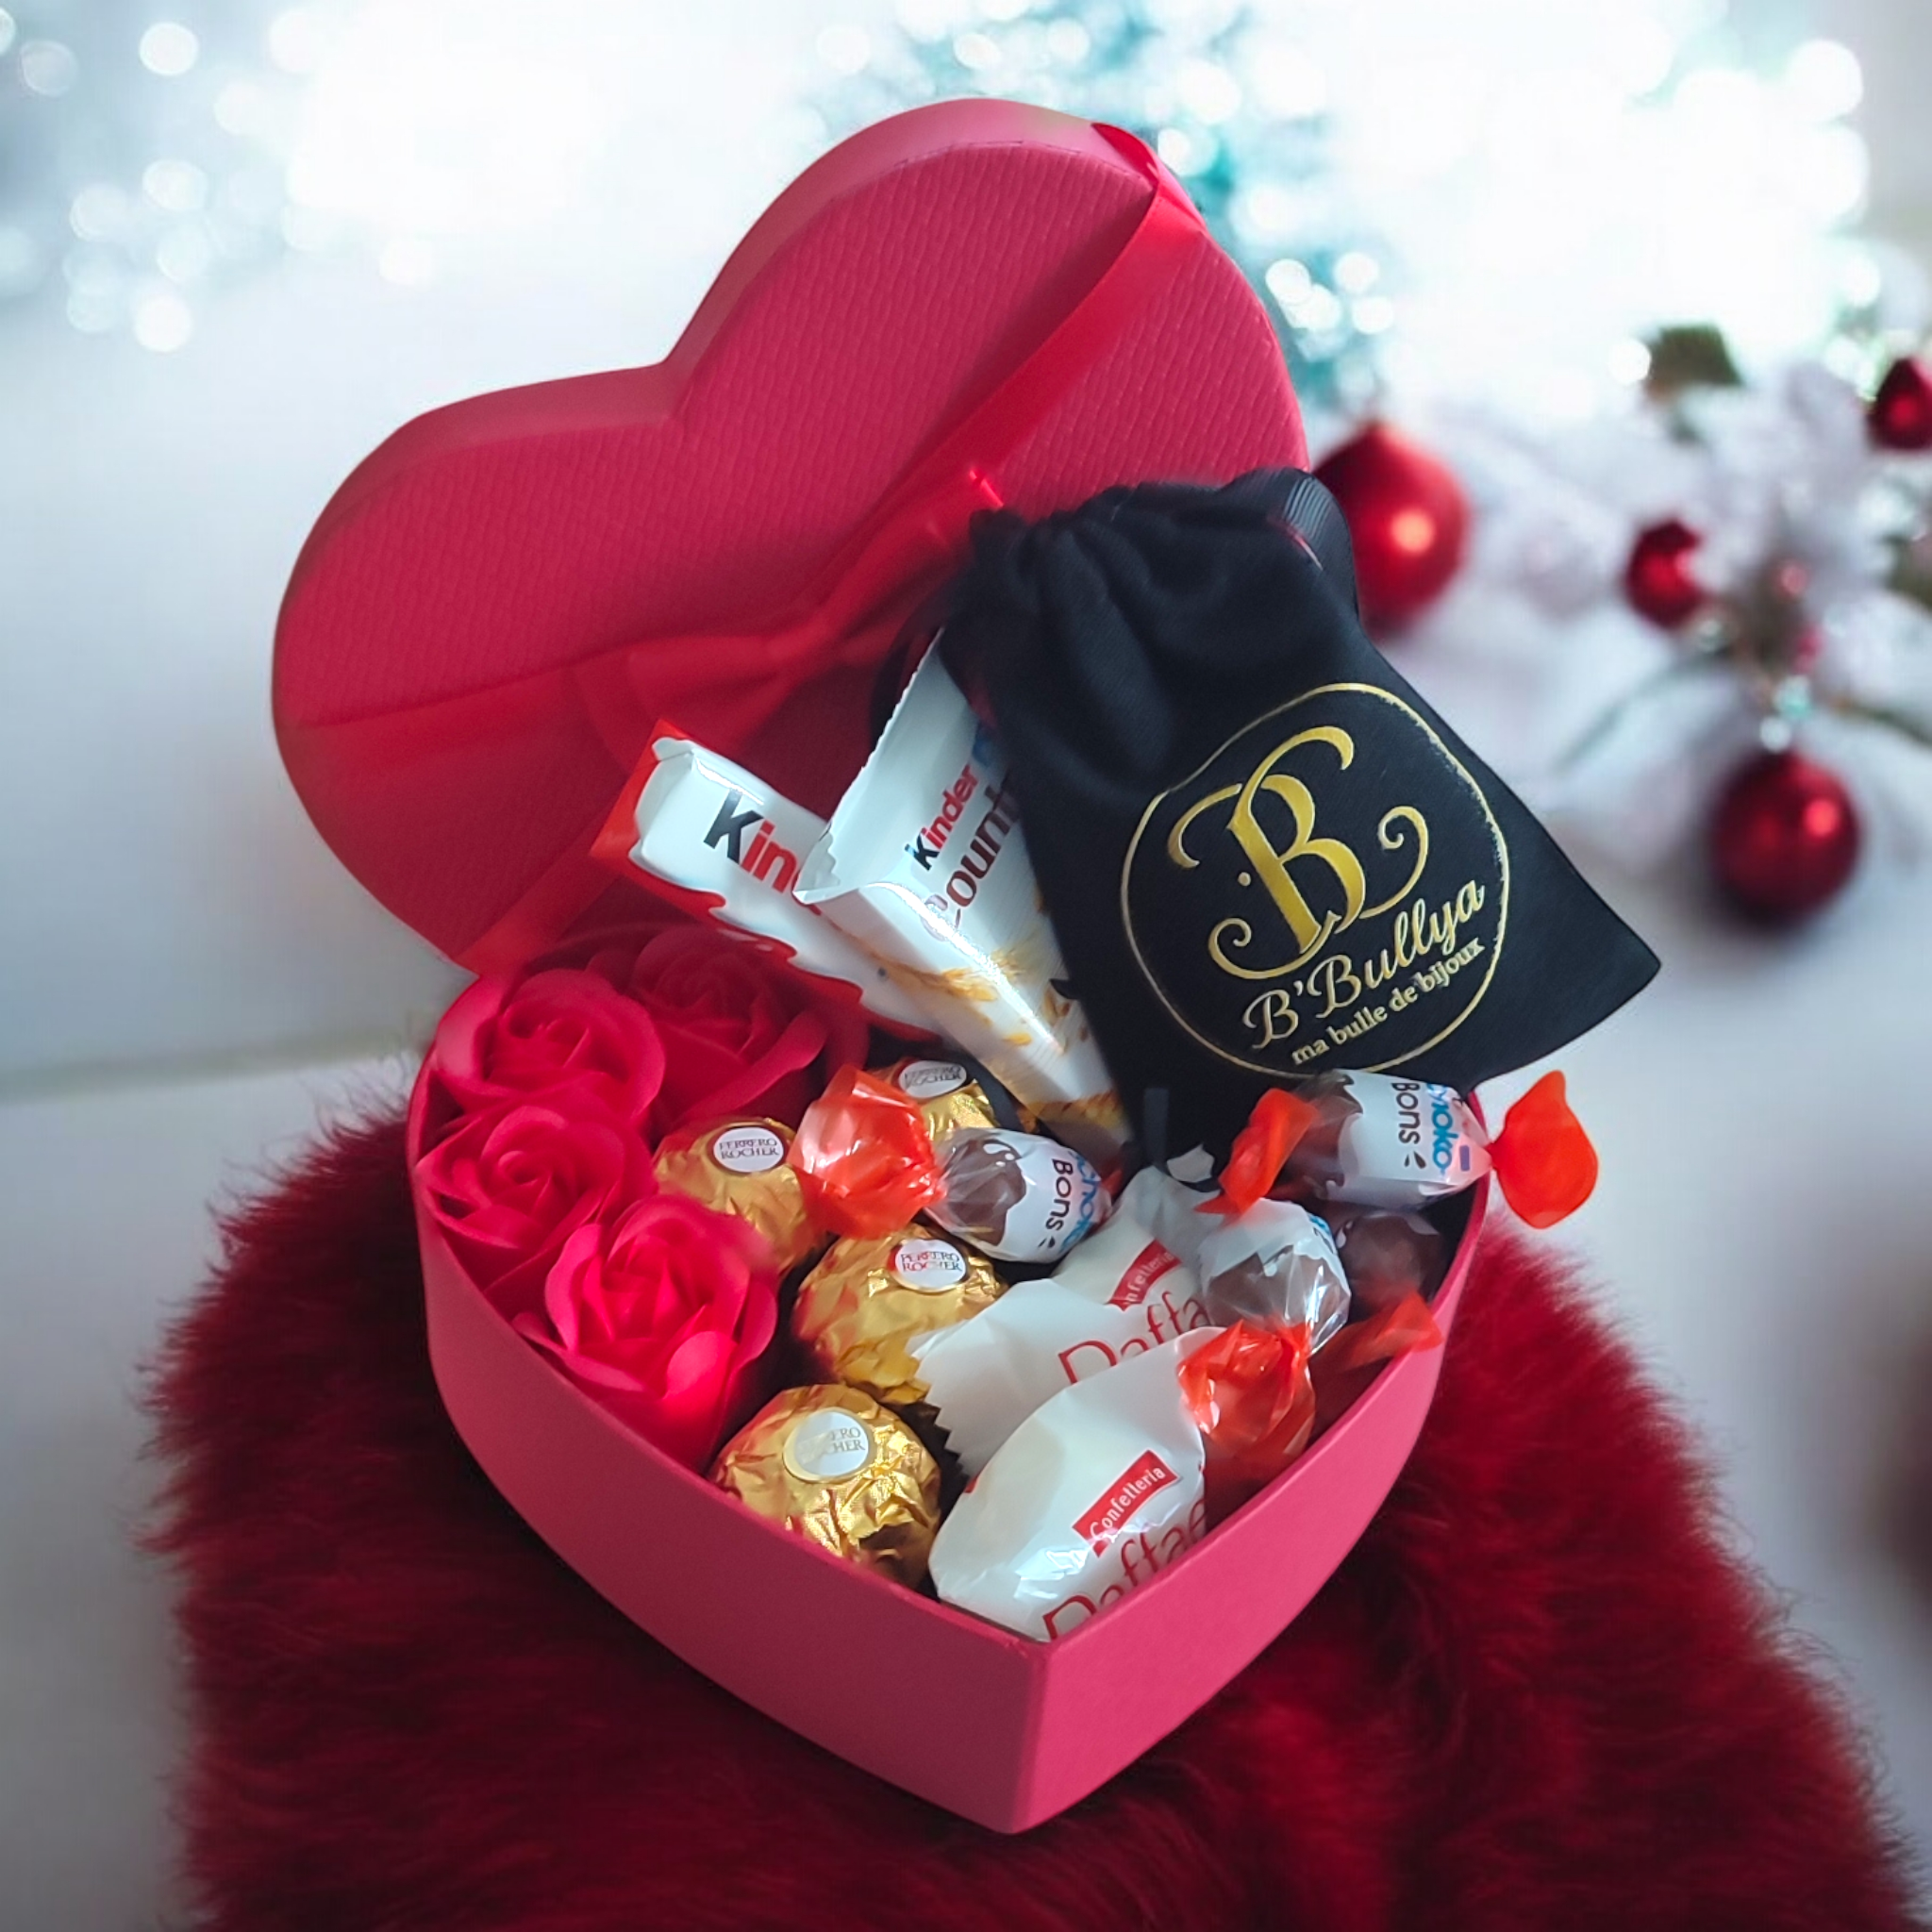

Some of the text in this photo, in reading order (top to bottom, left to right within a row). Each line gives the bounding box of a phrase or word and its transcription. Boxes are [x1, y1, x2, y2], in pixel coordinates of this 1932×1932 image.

[1292, 937, 1485, 1065] ma bulle de bijoux
[719, 1138, 777, 1150] FERRERO
[1391, 1082, 1422, 1144] Bons
[721, 1147, 780, 1159] ROCHER
[1045, 1158, 1074, 1231] Bons
